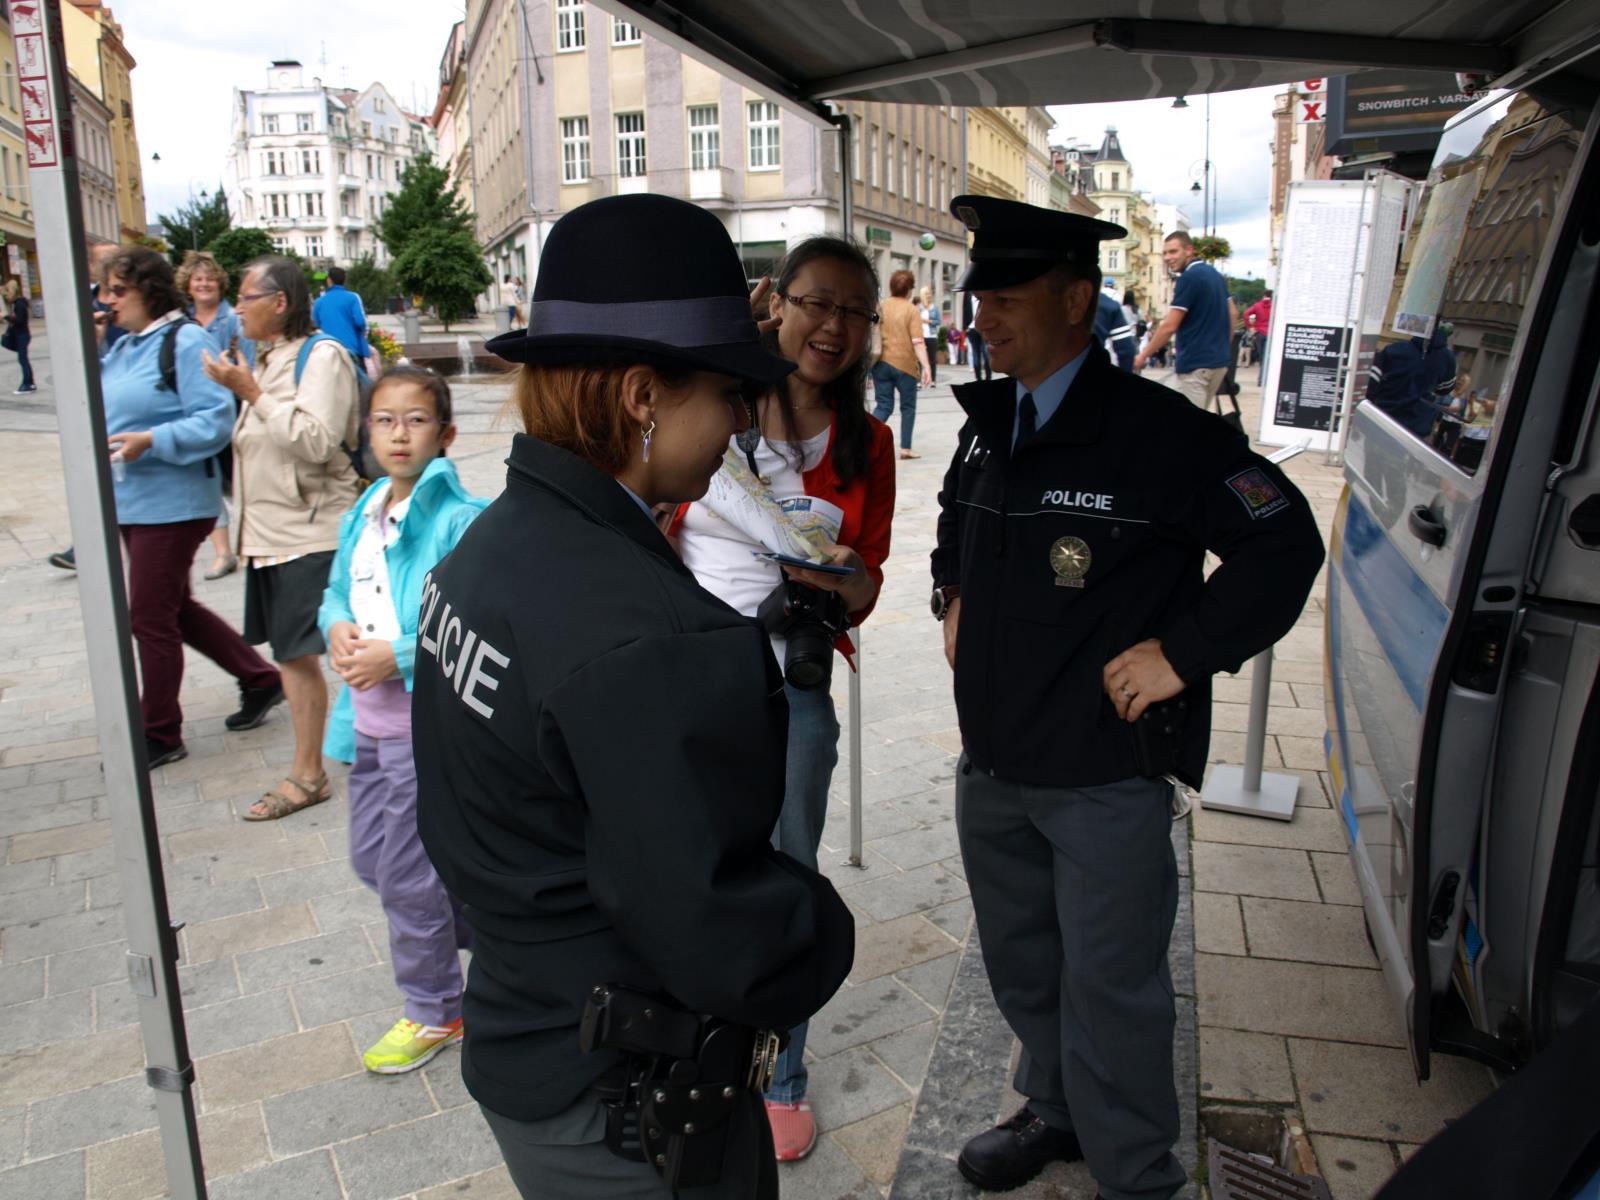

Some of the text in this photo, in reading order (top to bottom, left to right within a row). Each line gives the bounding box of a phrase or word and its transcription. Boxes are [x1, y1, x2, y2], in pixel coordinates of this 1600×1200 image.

[1357, 97, 1429, 111] SNOWBITCH
[1285, 343, 1326, 351] FESTIVALU
[1041, 490, 1114, 511] POLICIE
[418, 571, 511, 719] POLICIE
